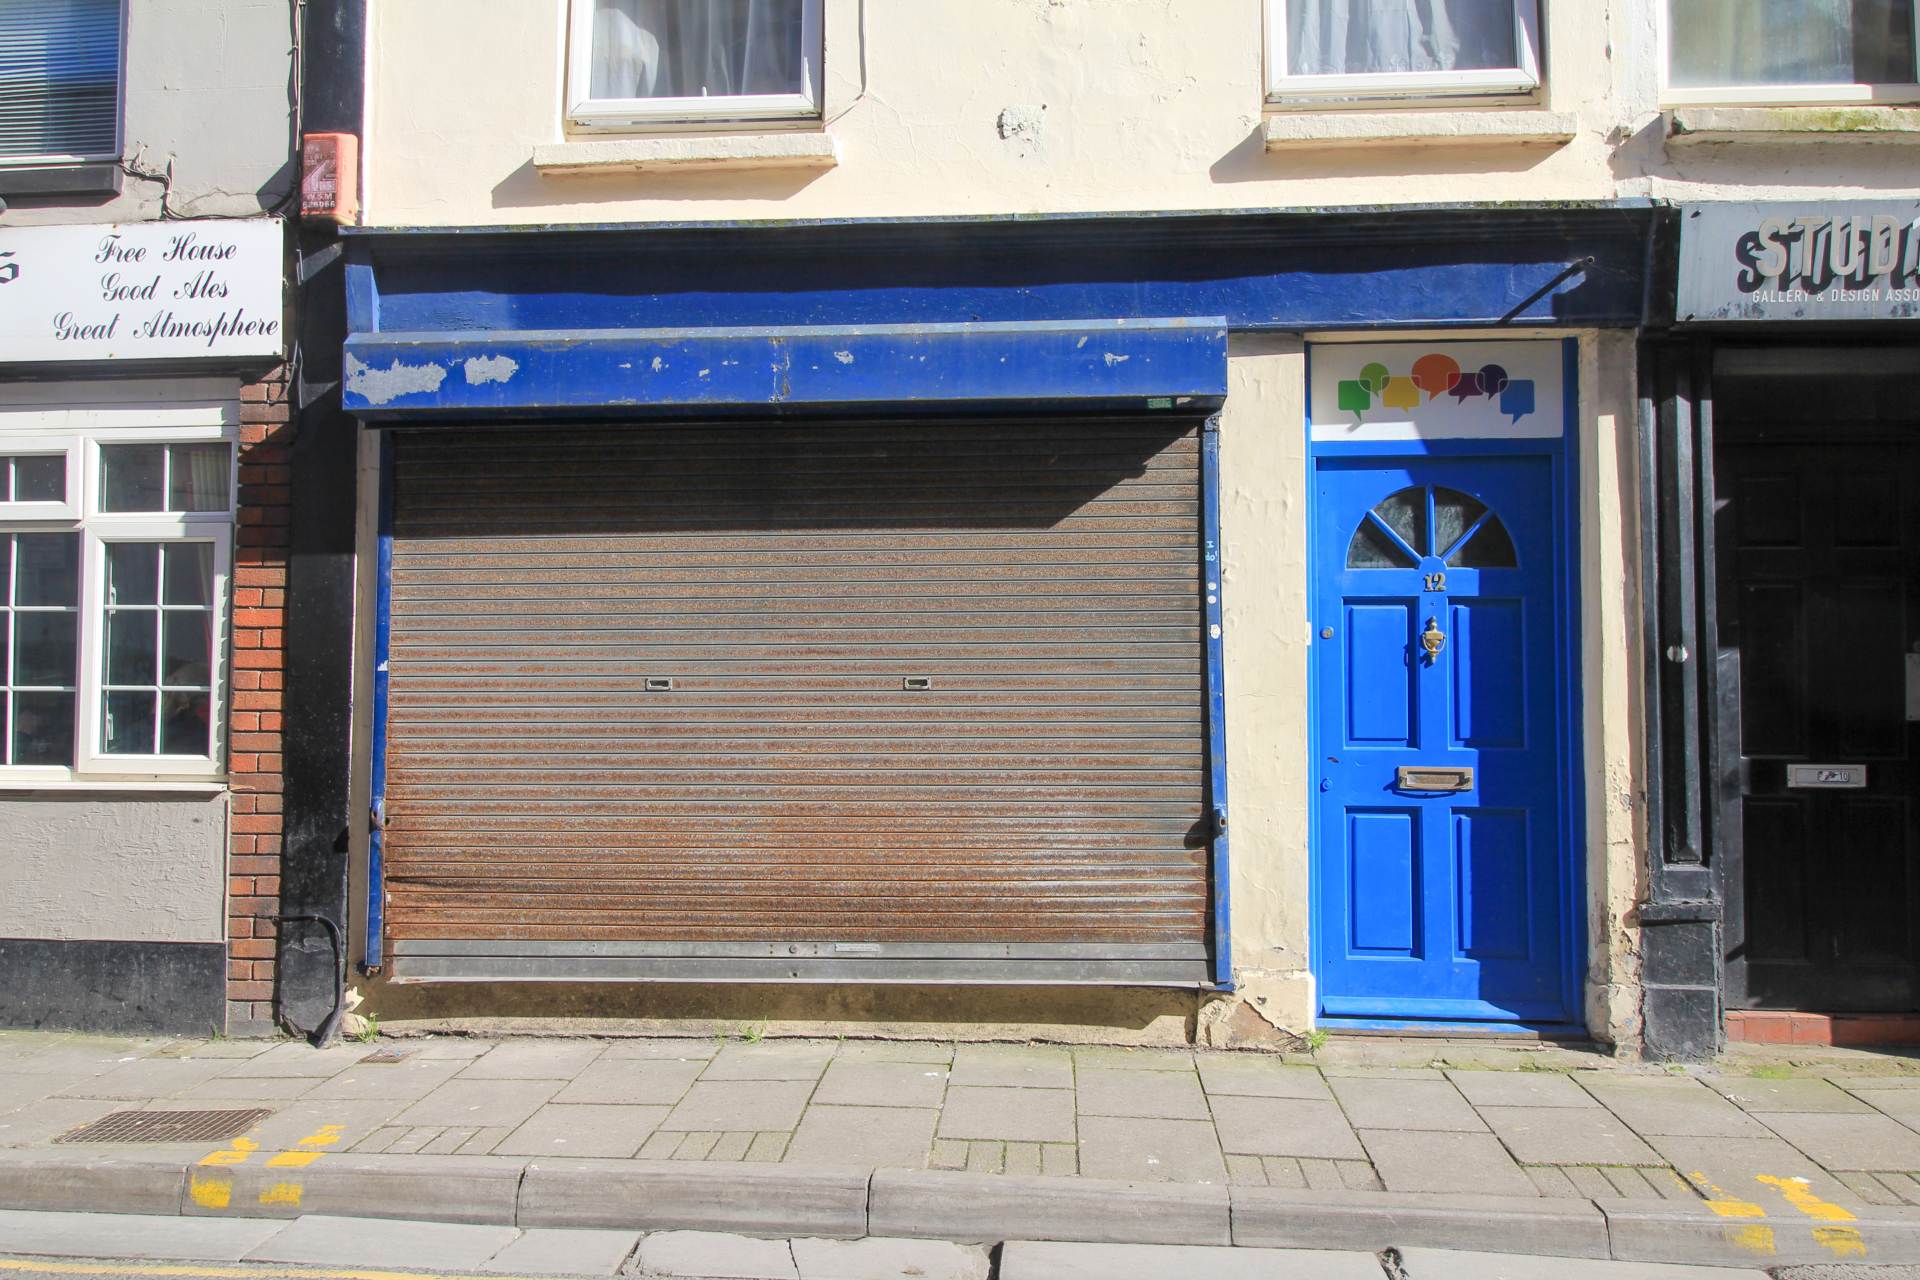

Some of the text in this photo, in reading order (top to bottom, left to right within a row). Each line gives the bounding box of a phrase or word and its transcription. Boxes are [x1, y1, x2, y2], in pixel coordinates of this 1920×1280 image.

[95, 232, 238, 264] Free House
[1755, 215, 1920, 277] STUD
[101, 270, 229, 301] Good Ales
[1752, 288, 1810, 303] GALLERY
[1816, 290, 1825, 301] &
[1832, 288, 1880, 302] DESIGN
[53, 307, 279, 348] Great Atmosphere
[1423, 573, 1447, 592] 12
